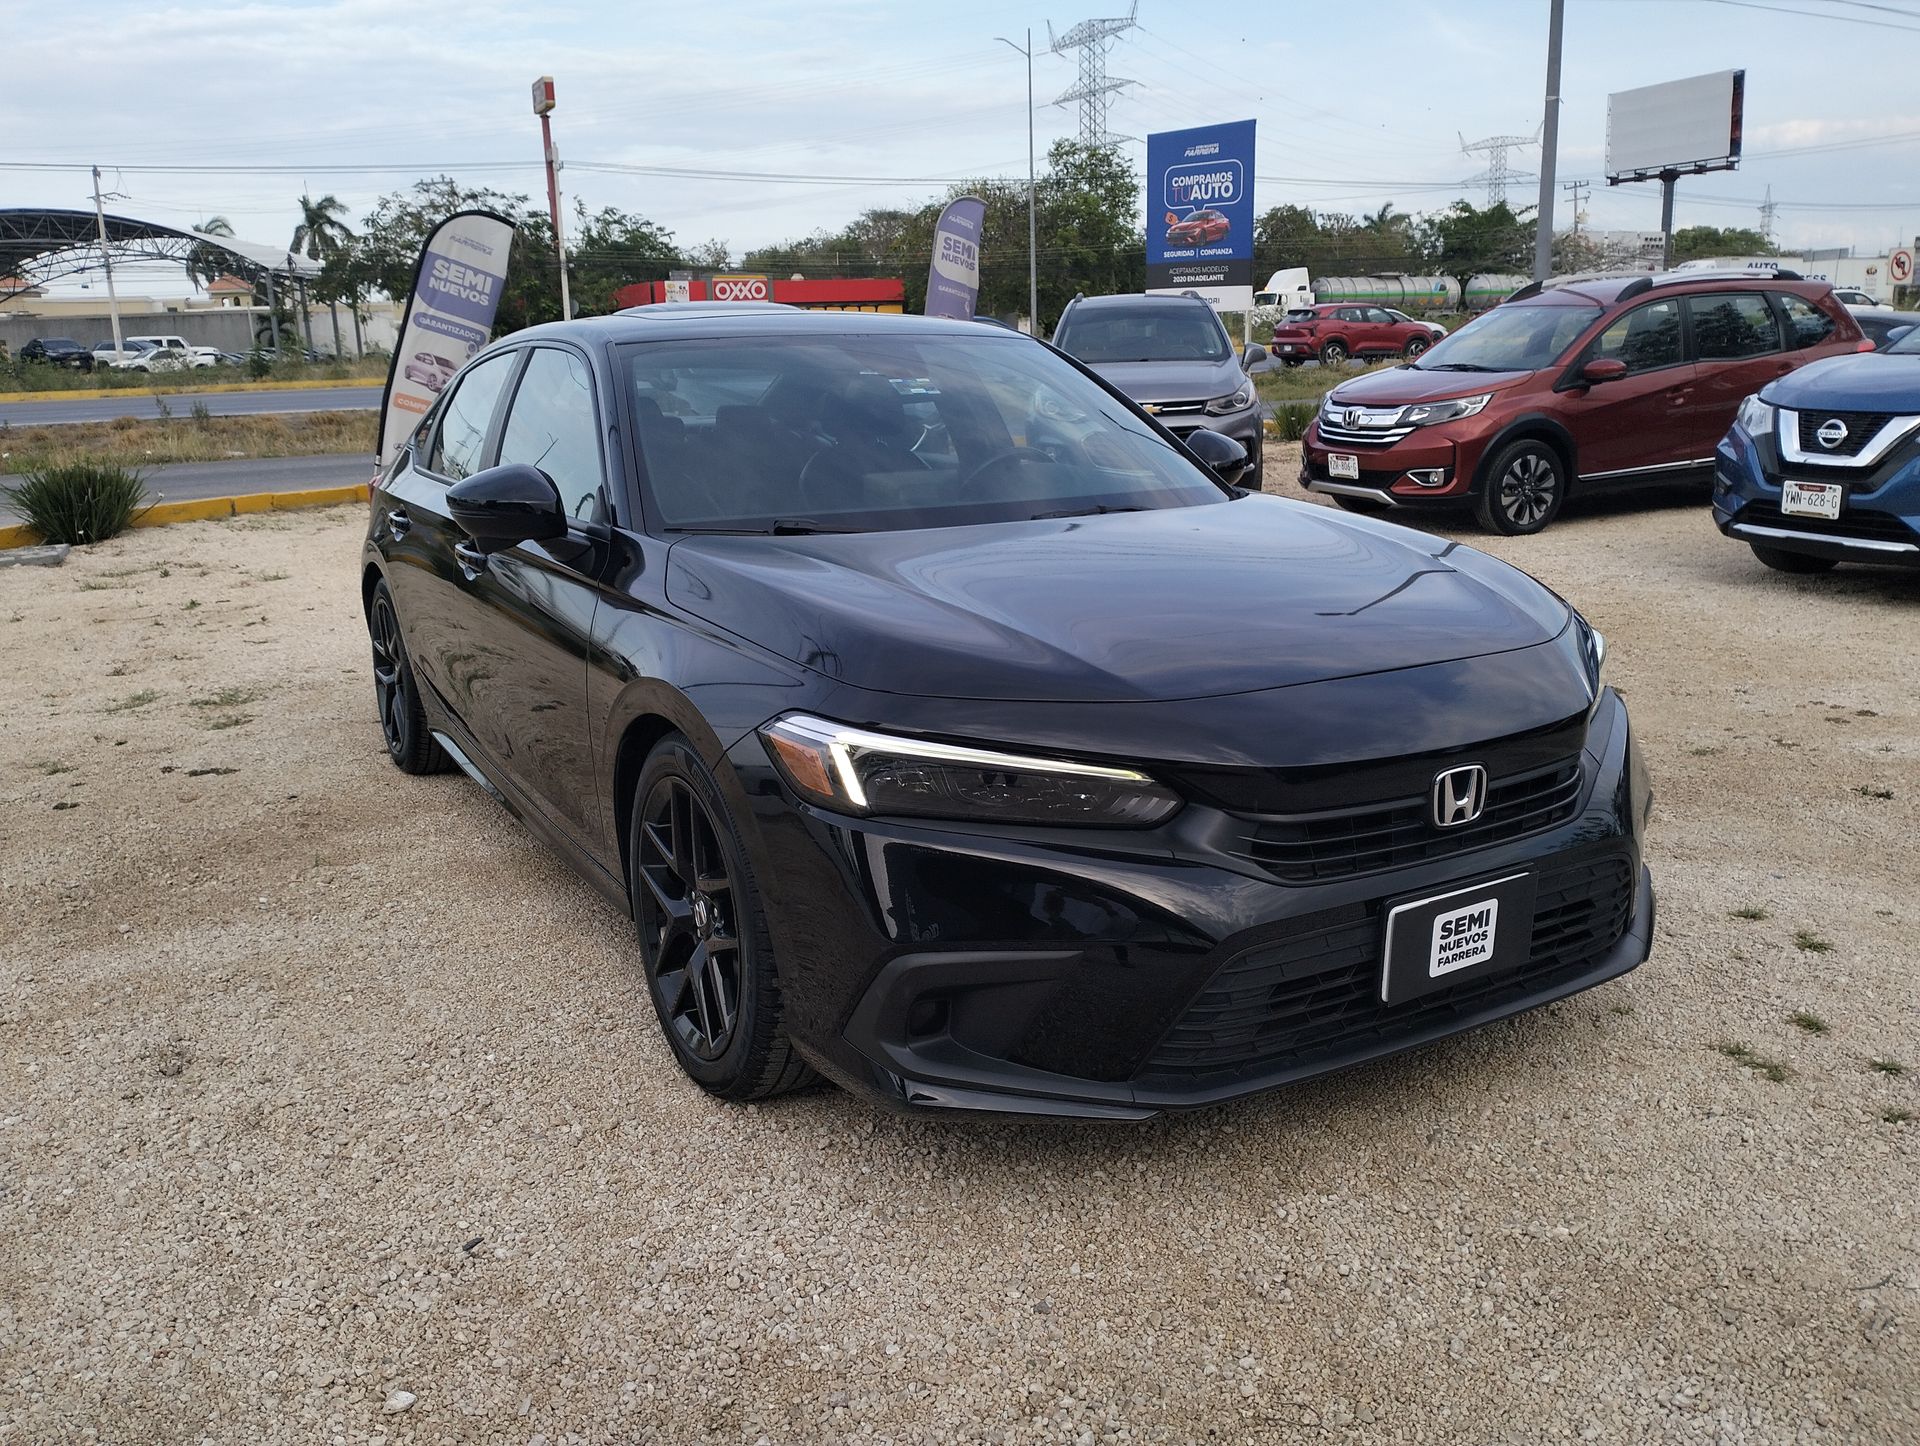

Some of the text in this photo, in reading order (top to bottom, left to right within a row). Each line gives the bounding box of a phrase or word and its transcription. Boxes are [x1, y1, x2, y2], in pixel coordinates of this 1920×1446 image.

[1172, 171, 1233, 187] COMPRAMOS
[943, 236, 976, 261] SEMI
[1163, 247, 1233, 258] SEGURIDAD CONFIANZA
[941, 252, 976, 271] NUEVOS
[1202, 265, 1230, 273] MODELOS
[432, 259, 493, 294] SEMI
[428, 276, 489, 306] NUEVOS
[715, 281, 767, 300] OXXO
[419, 316, 482, 340] GARANTIZADOS
[1785, 490, 1838, 509] YWN-628-G
[1439, 908, 1491, 940] SEMI
[1438, 930, 1488, 954] NUEVOS
[1437, 945, 1486, 968] FARRERA
